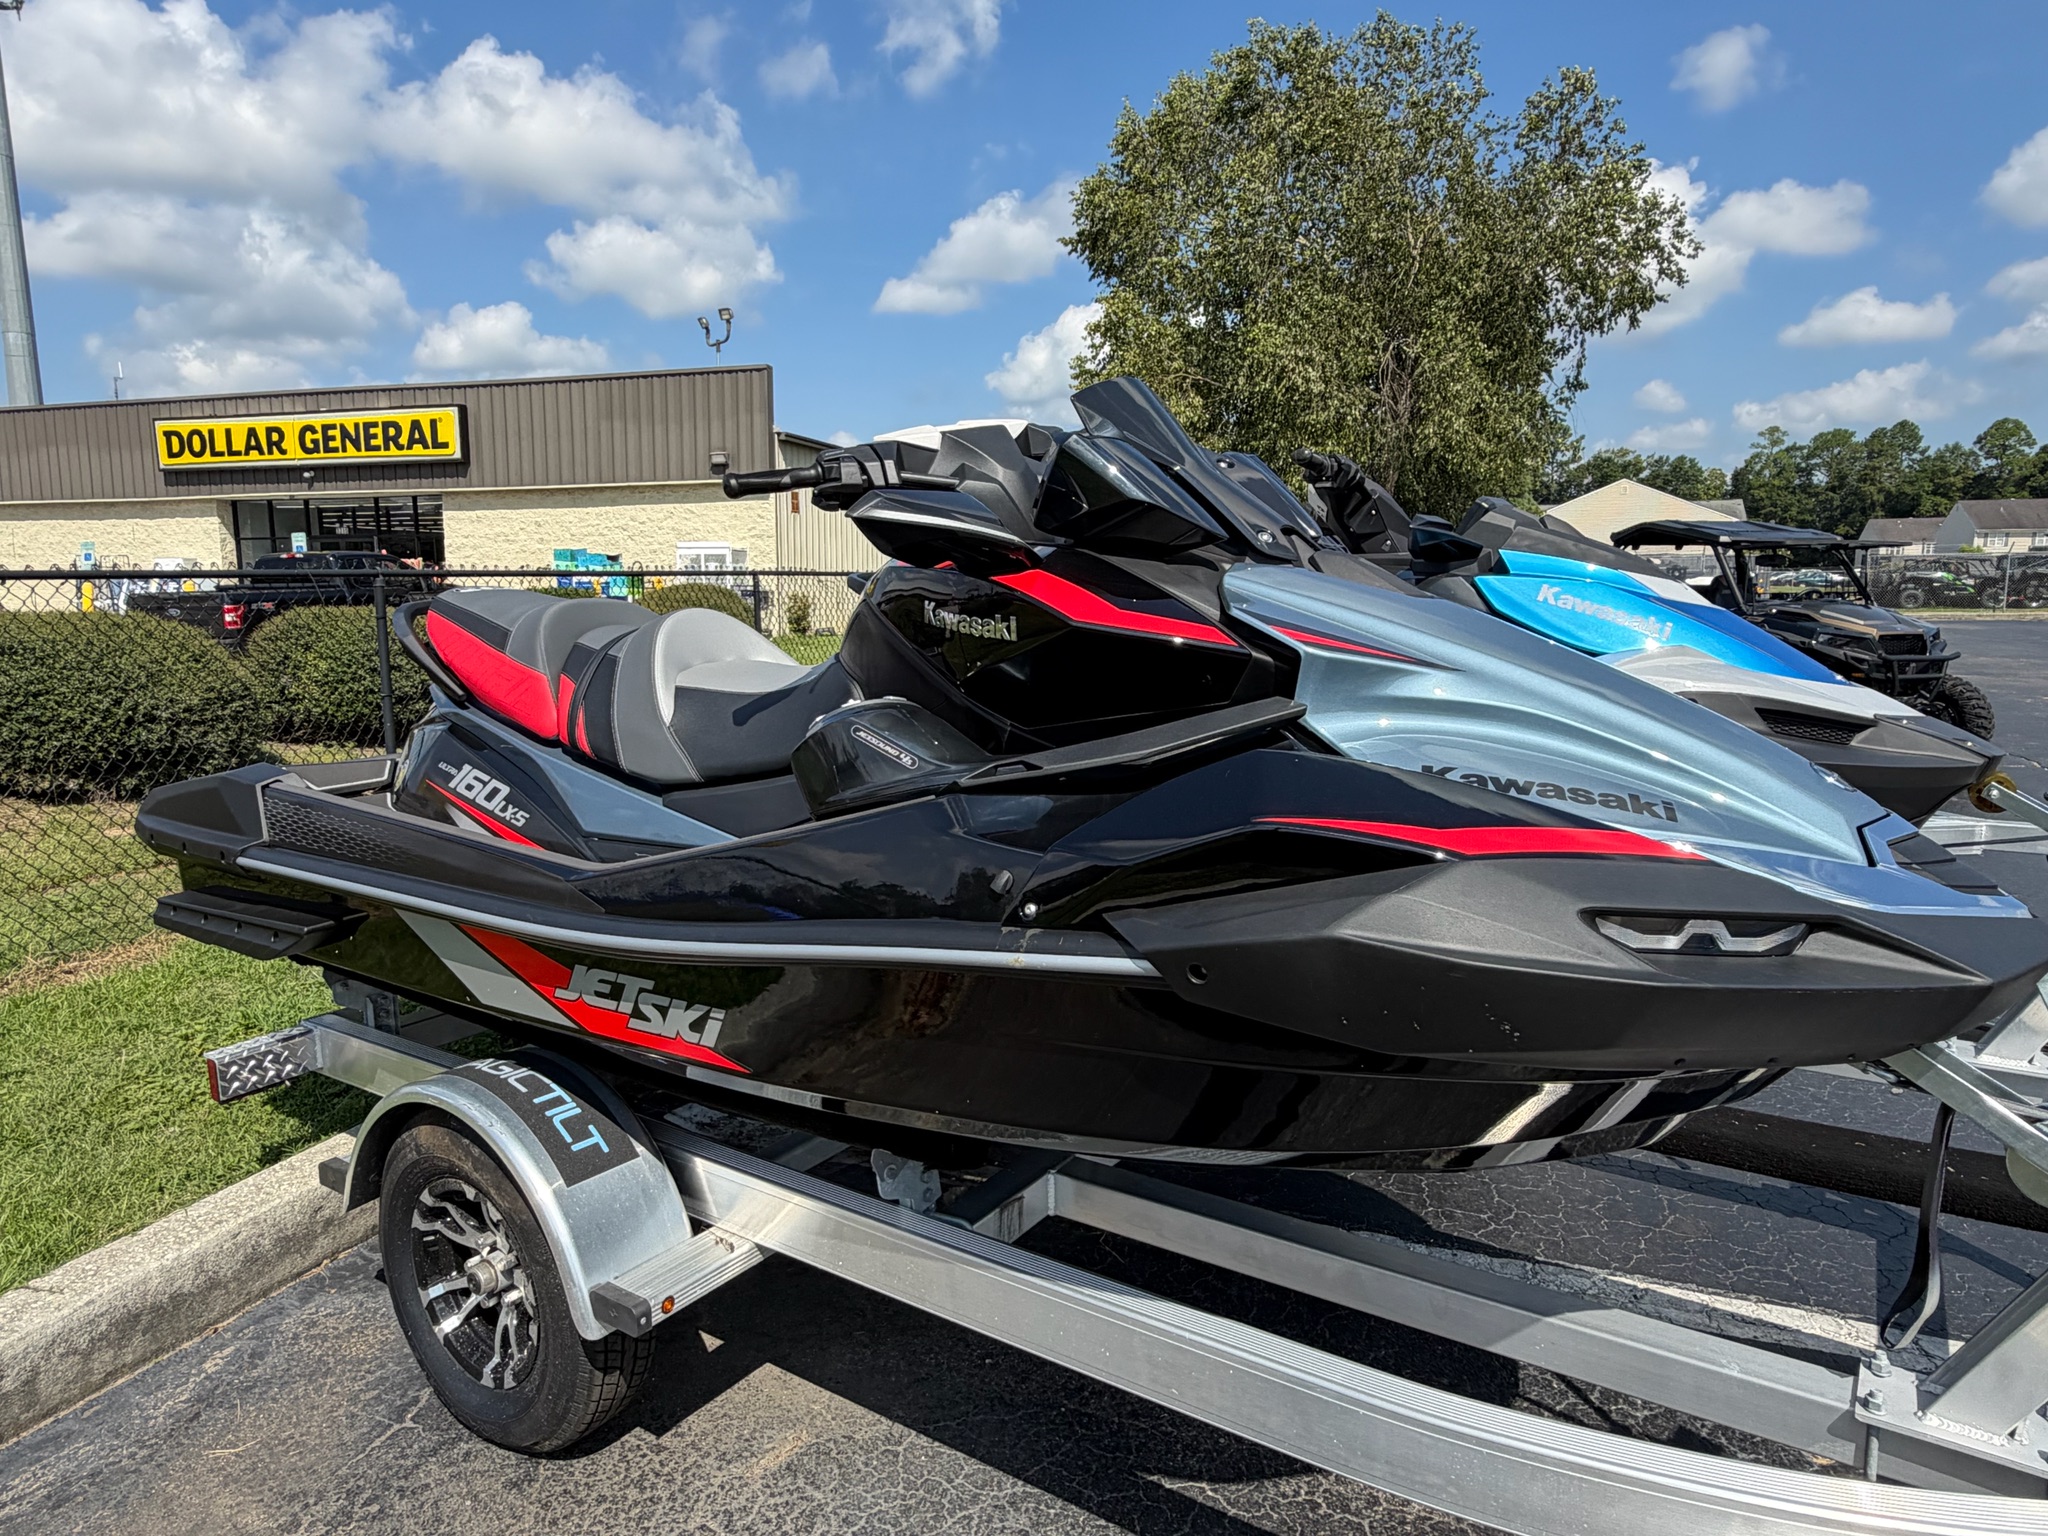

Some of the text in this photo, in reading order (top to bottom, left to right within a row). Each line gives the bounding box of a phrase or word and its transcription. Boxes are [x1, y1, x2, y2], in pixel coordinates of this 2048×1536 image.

[162, 418, 450, 459] DOLLAR GENERAL
[923, 600, 1018, 642] Kawasaki
[1536, 584, 1673, 641] Kawasaki
[438, 761, 459, 777] ULTRA
